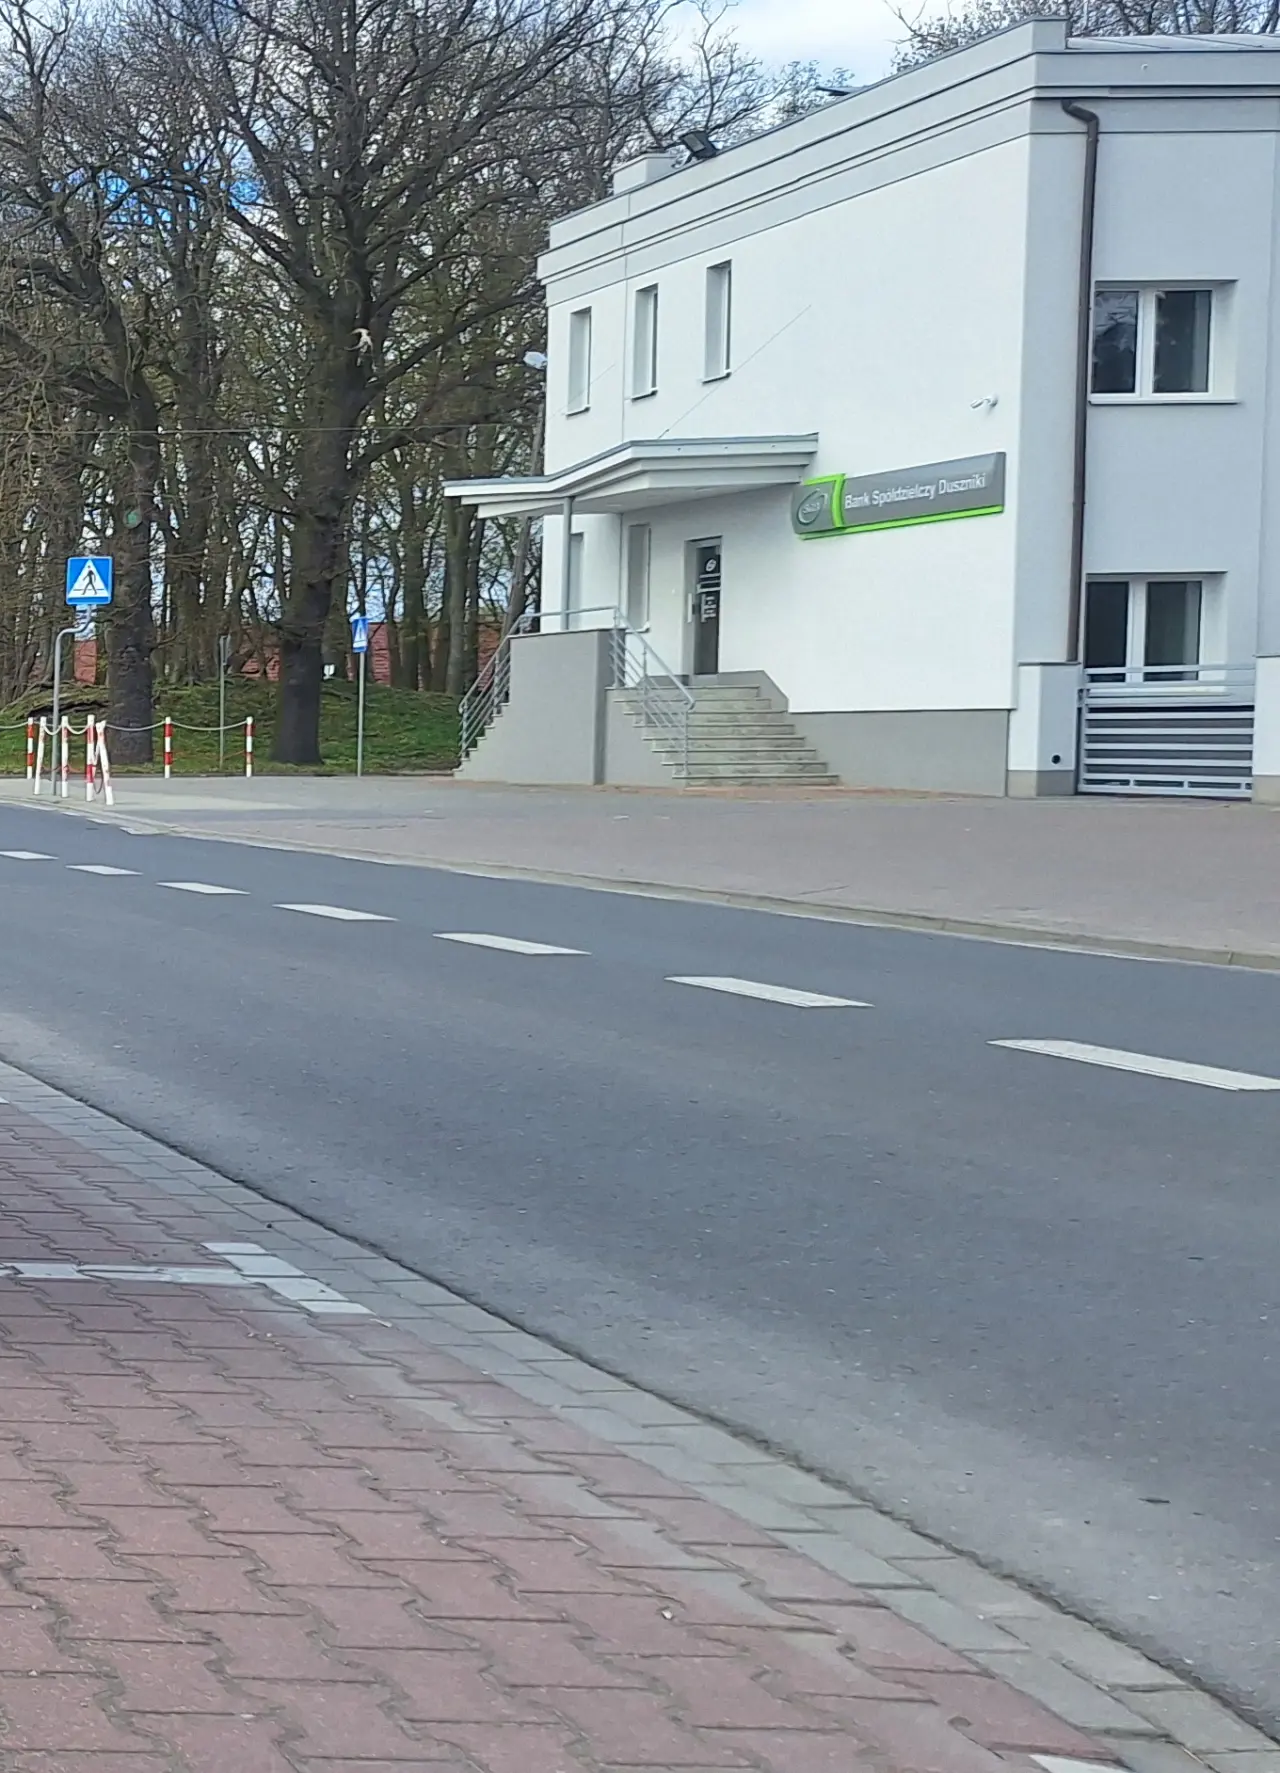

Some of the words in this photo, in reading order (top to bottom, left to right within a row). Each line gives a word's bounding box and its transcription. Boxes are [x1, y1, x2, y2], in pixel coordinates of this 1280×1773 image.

[844, 492, 870, 509] Bank
[872, 483, 936, 507] Spółdzielczy
[938, 473, 986, 495] Duszniki
